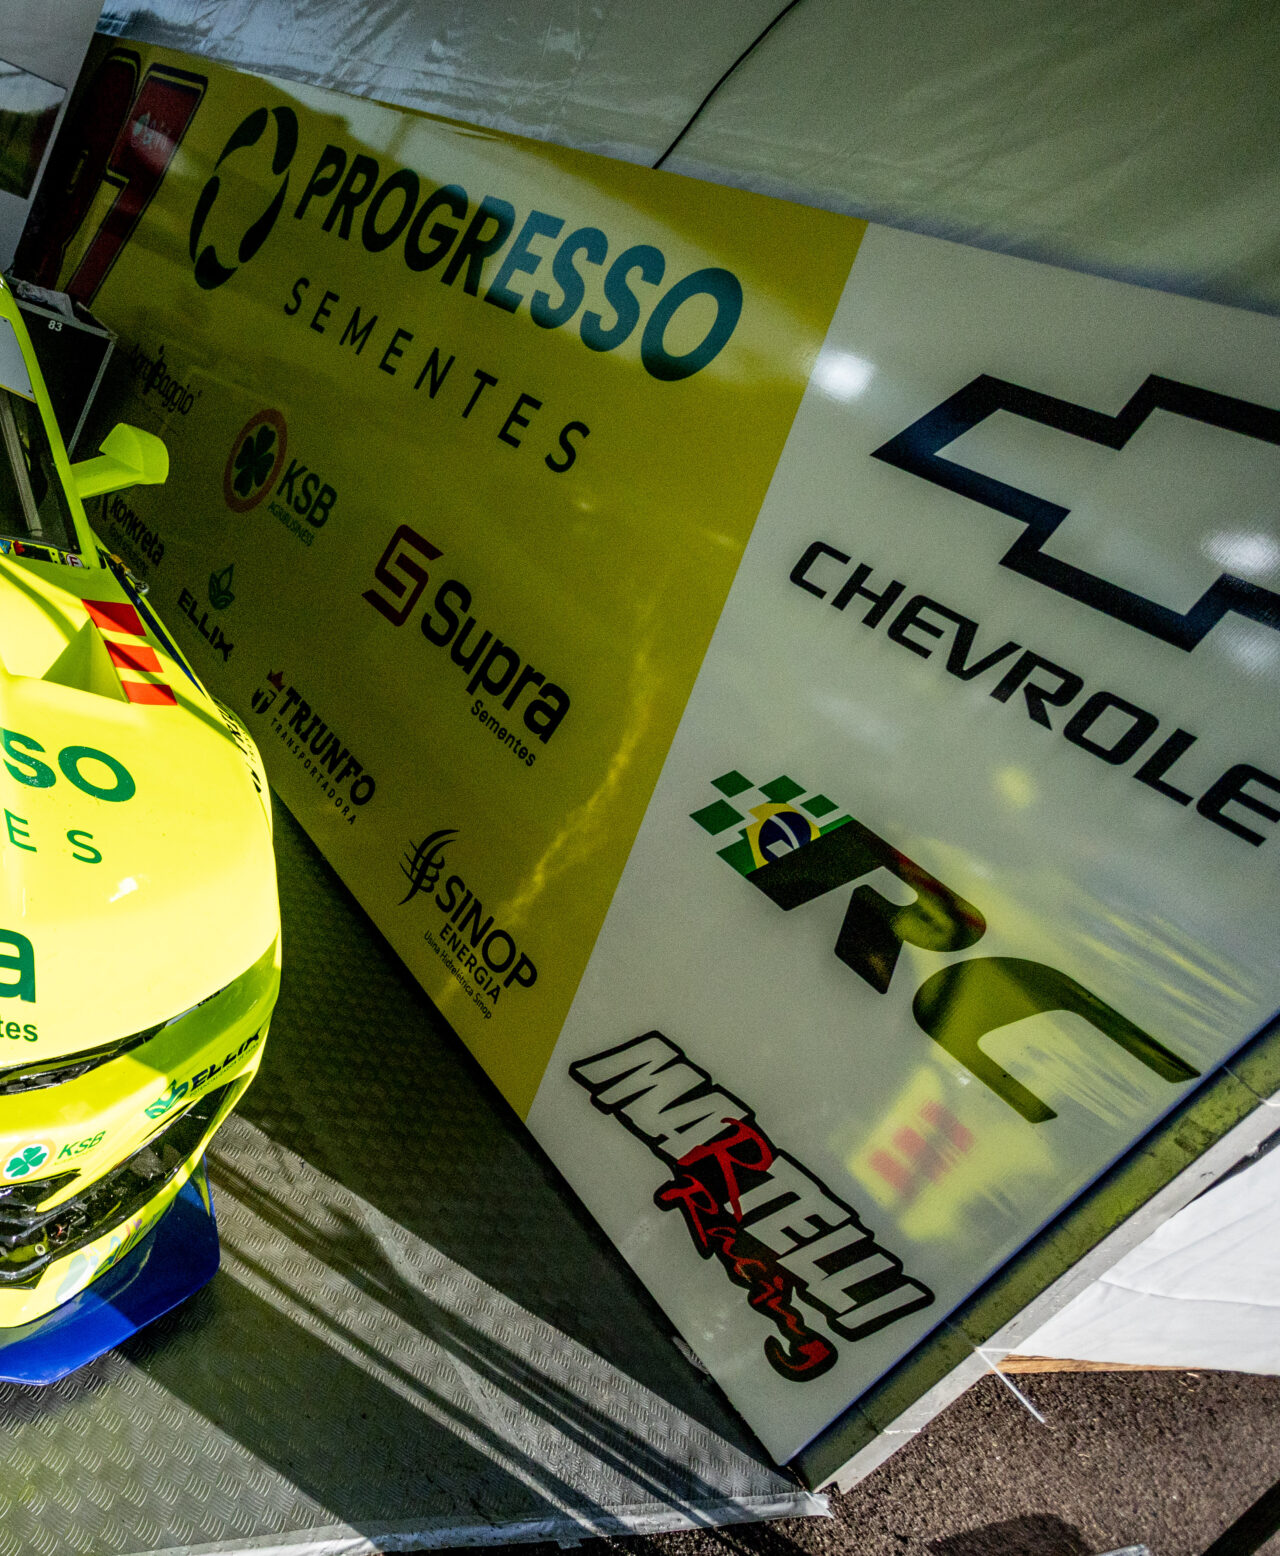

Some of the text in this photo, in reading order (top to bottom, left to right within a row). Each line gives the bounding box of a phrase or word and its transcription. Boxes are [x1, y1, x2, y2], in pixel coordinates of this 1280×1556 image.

[293, 144, 744, 382] PROGRESSO
[48, 320, 63, 332] 83
[283, 277, 592, 474] SEMENTES
[277, 458, 337, 528] KSB
[178, 588, 234, 662] ELLIX
[421, 579, 570, 744] Supra
[271, 717, 357, 826] TRANSPORTADORA
[279, 686, 375, 806] TRIUNFO
[470, 699, 537, 767] Sementes
[436, 876, 537, 988] SINOP
[439, 923, 500, 1005] ENERGIA
[57, 1130, 106, 1159] KSB
[570, 1030, 936, 1342] MARTELLI
